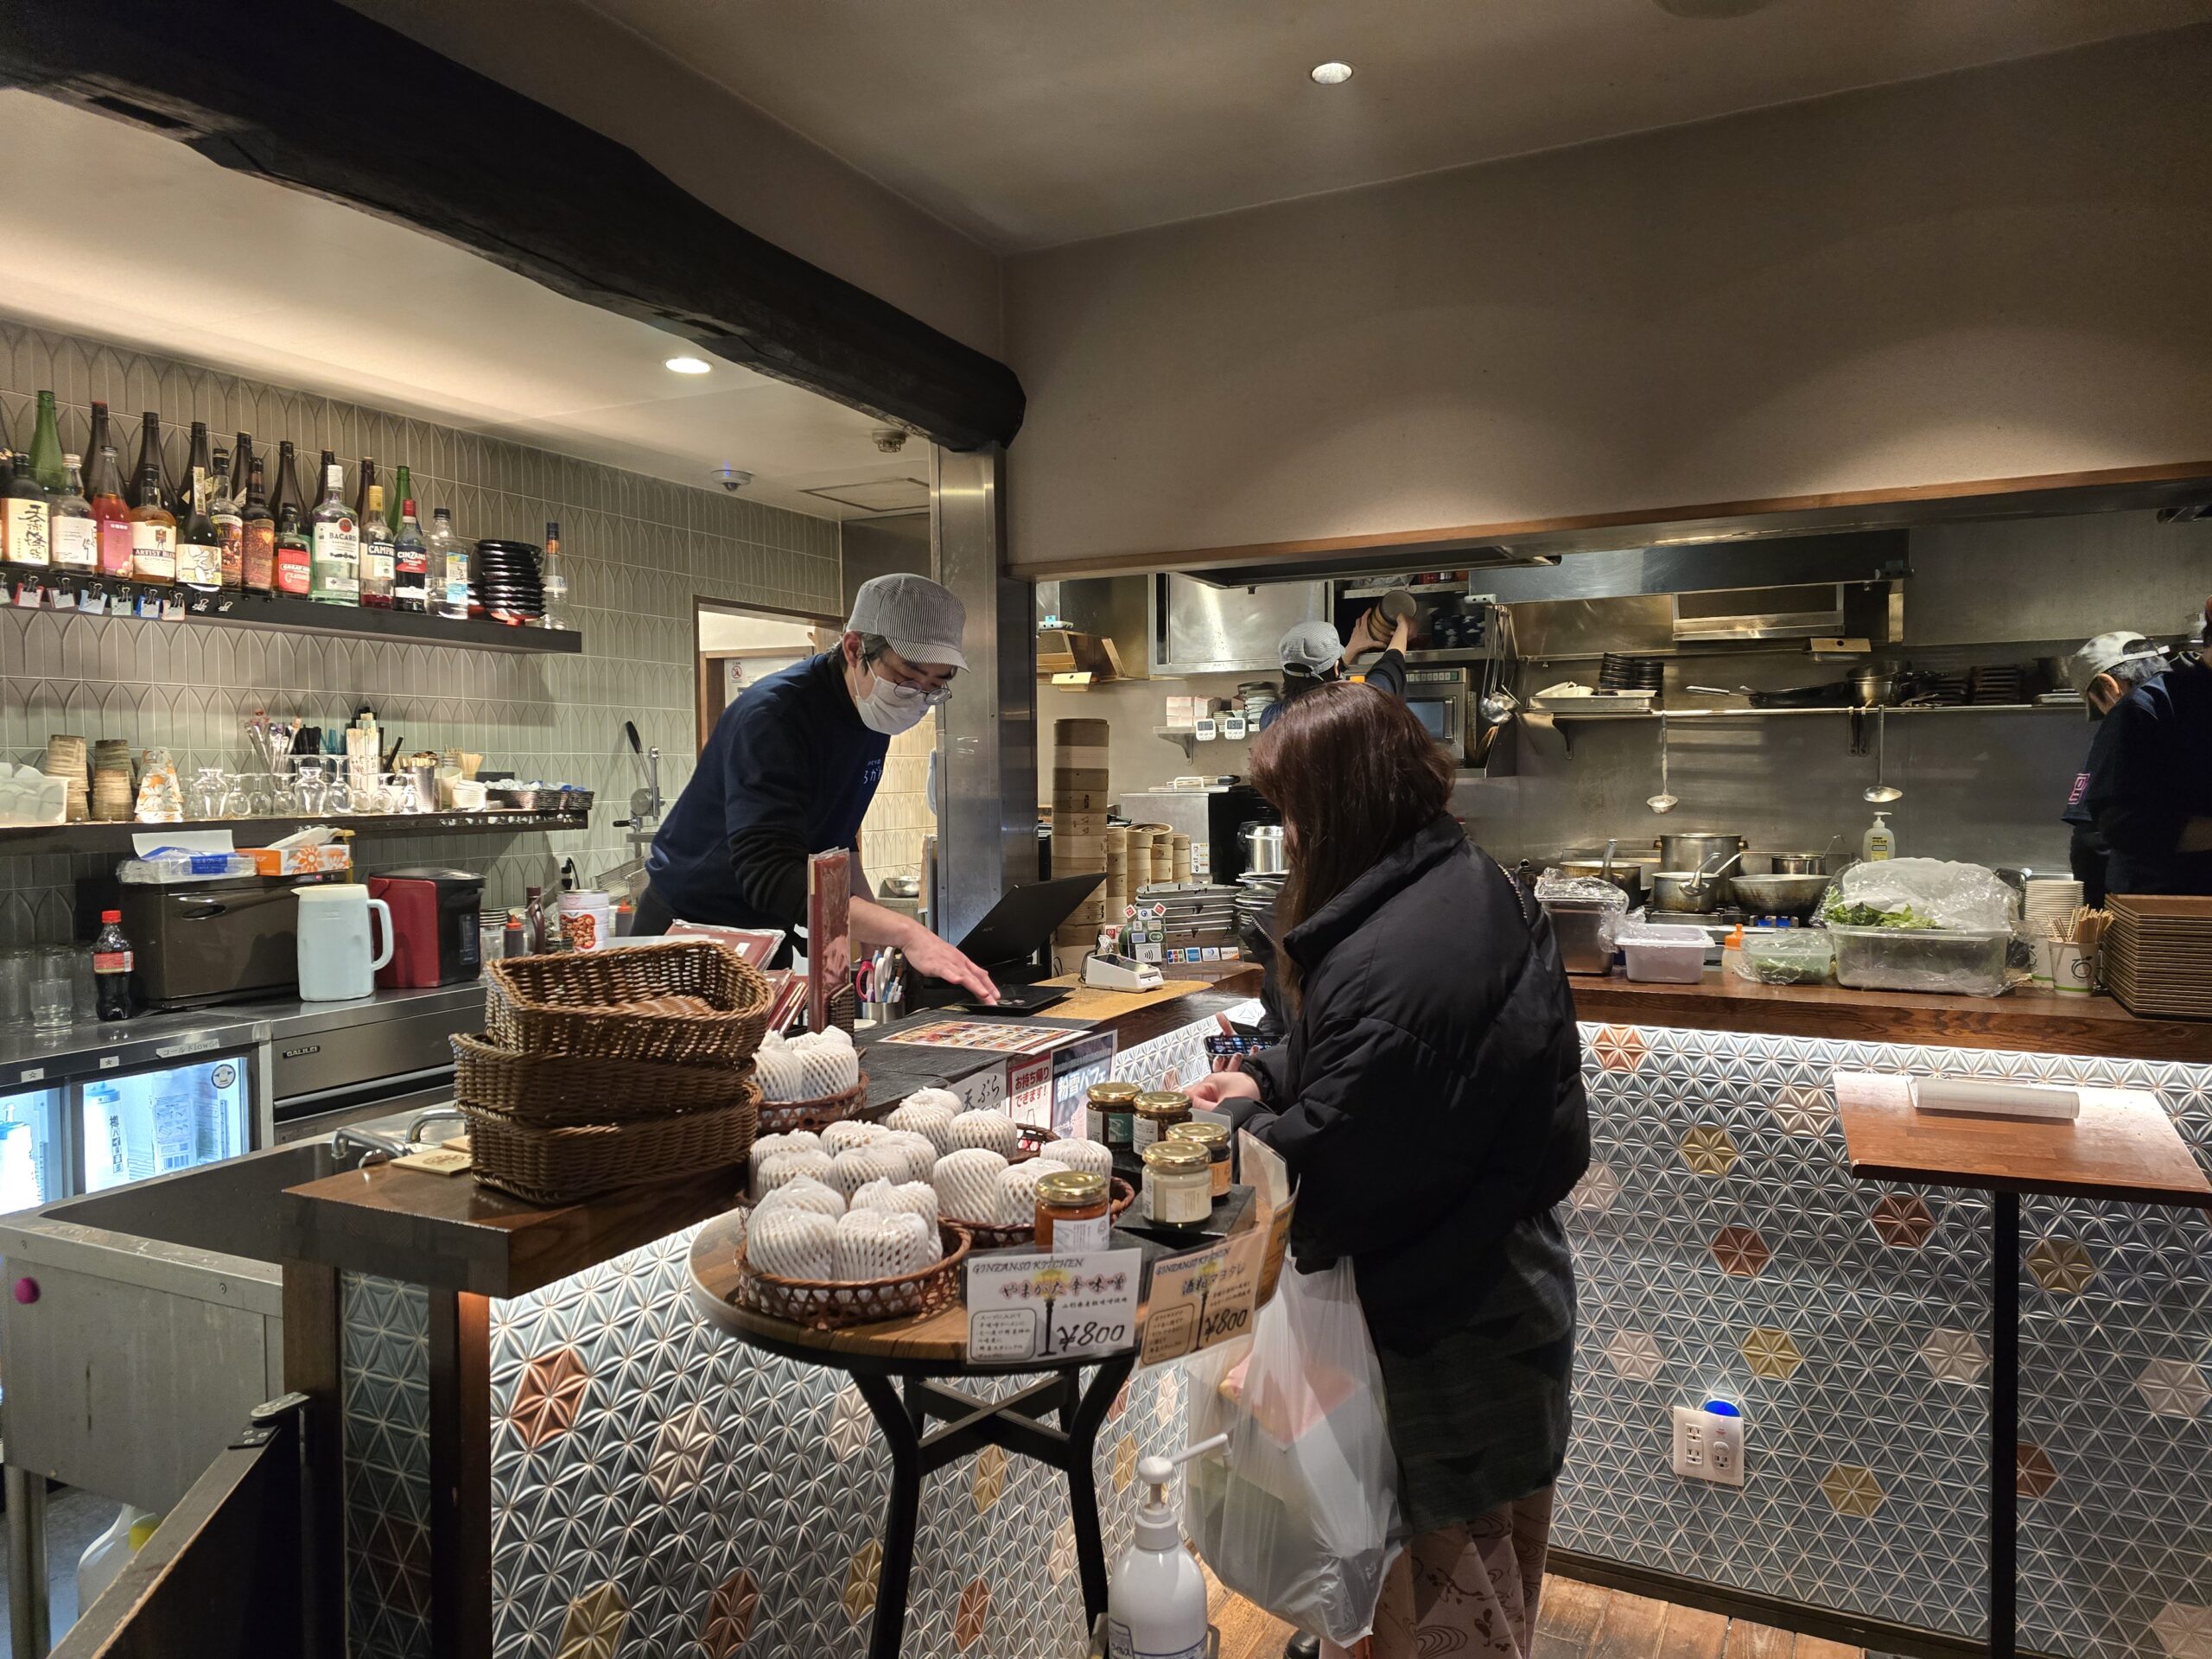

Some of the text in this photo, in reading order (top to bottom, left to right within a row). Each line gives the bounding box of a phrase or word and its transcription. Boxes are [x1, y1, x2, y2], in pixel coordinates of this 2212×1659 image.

[397, 551, 426, 561] CINZANO
[286, 1046, 317, 1057] GALILEI
[1015, 1065, 1049, 1090] お持ち帰り
[1057, 1066, 1106, 1103] 粉雪パフェ
[963, 1075, 1000, 1113] 天ぷら
[972, 1258, 1084, 1274] GINZANSO KITCHEN
[1057, 1321, 1125, 1352] ¥800
[1205, 1308, 1248, 1342] ¥800
